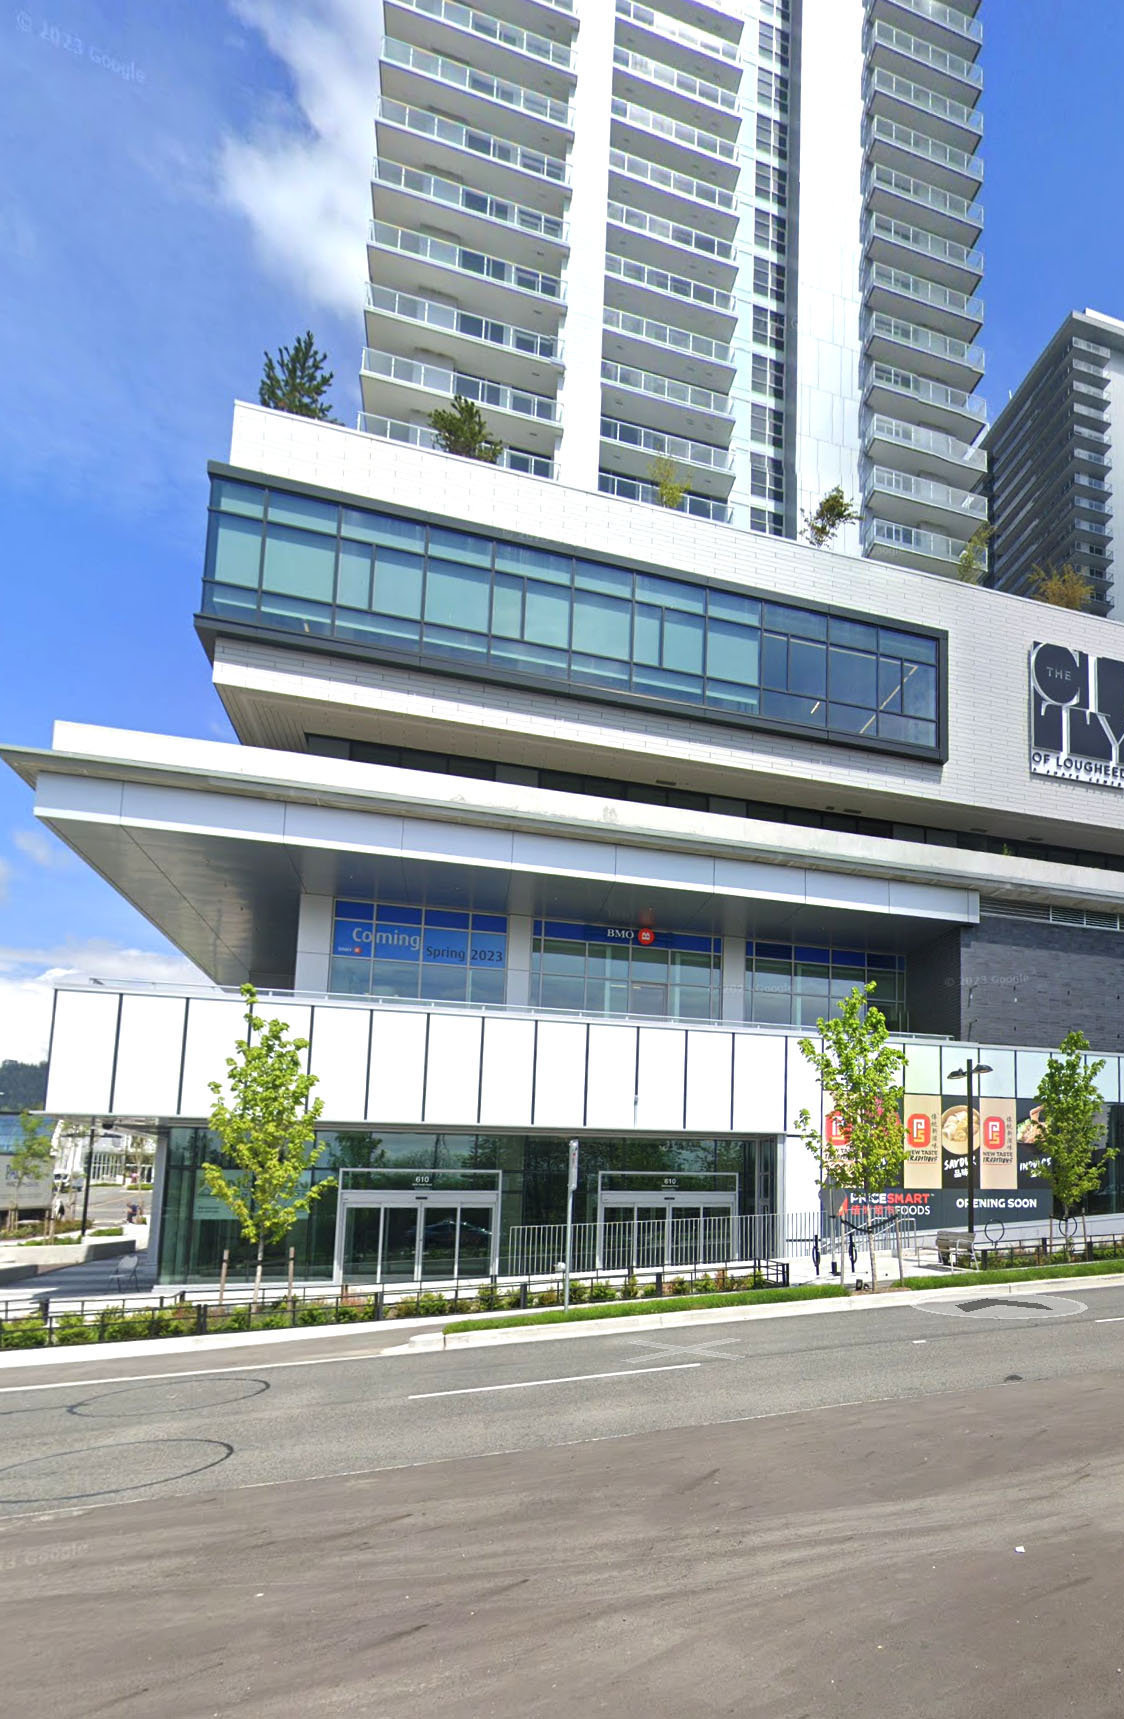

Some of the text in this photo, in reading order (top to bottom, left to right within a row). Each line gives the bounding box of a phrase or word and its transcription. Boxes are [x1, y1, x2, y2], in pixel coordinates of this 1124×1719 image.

[1046, 666, 1072, 681] THE
[1032, 752, 1051, 765] OF
[352, 928, 420, 951] Coming
[607, 928, 635, 939] BMO
[426, 946, 504, 962] Spring 2023
[1007, 1199, 1037, 1208] SOON
[895, 1206, 931, 1215] FOODS
